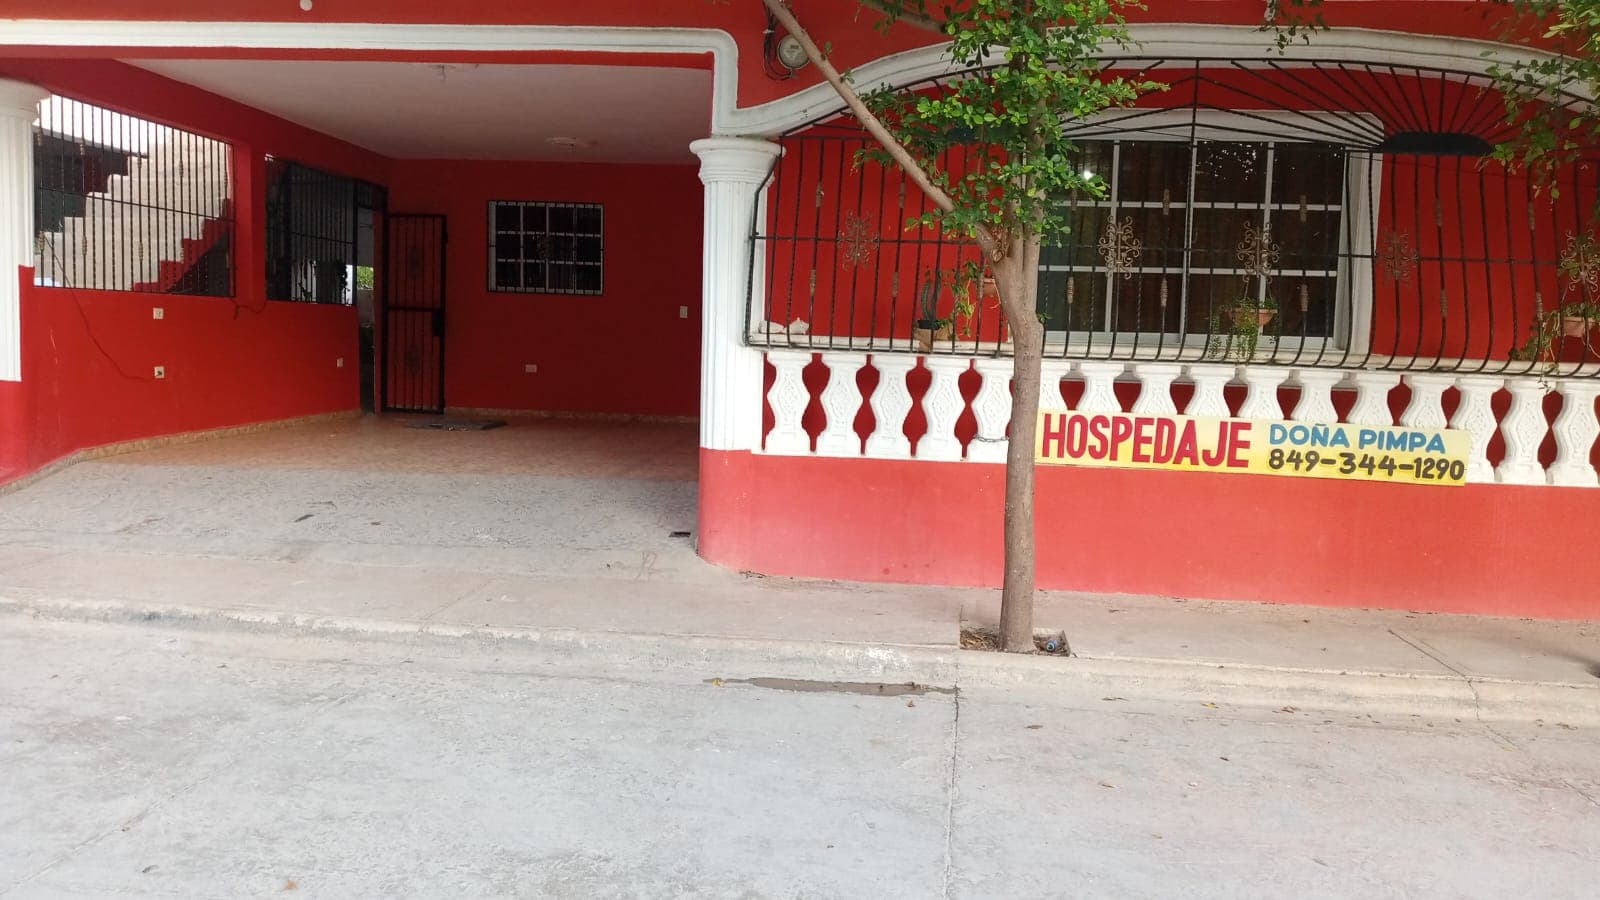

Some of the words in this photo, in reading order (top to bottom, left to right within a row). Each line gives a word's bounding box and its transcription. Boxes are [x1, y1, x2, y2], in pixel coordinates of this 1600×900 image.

[1042, 413, 1252, 468] HOSPEDAJE
[1269, 423, 1350, 448] DOÑA
[1358, 429, 1446, 453] PIMPA
[1268, 449, 1465, 481] 849-344-1290
